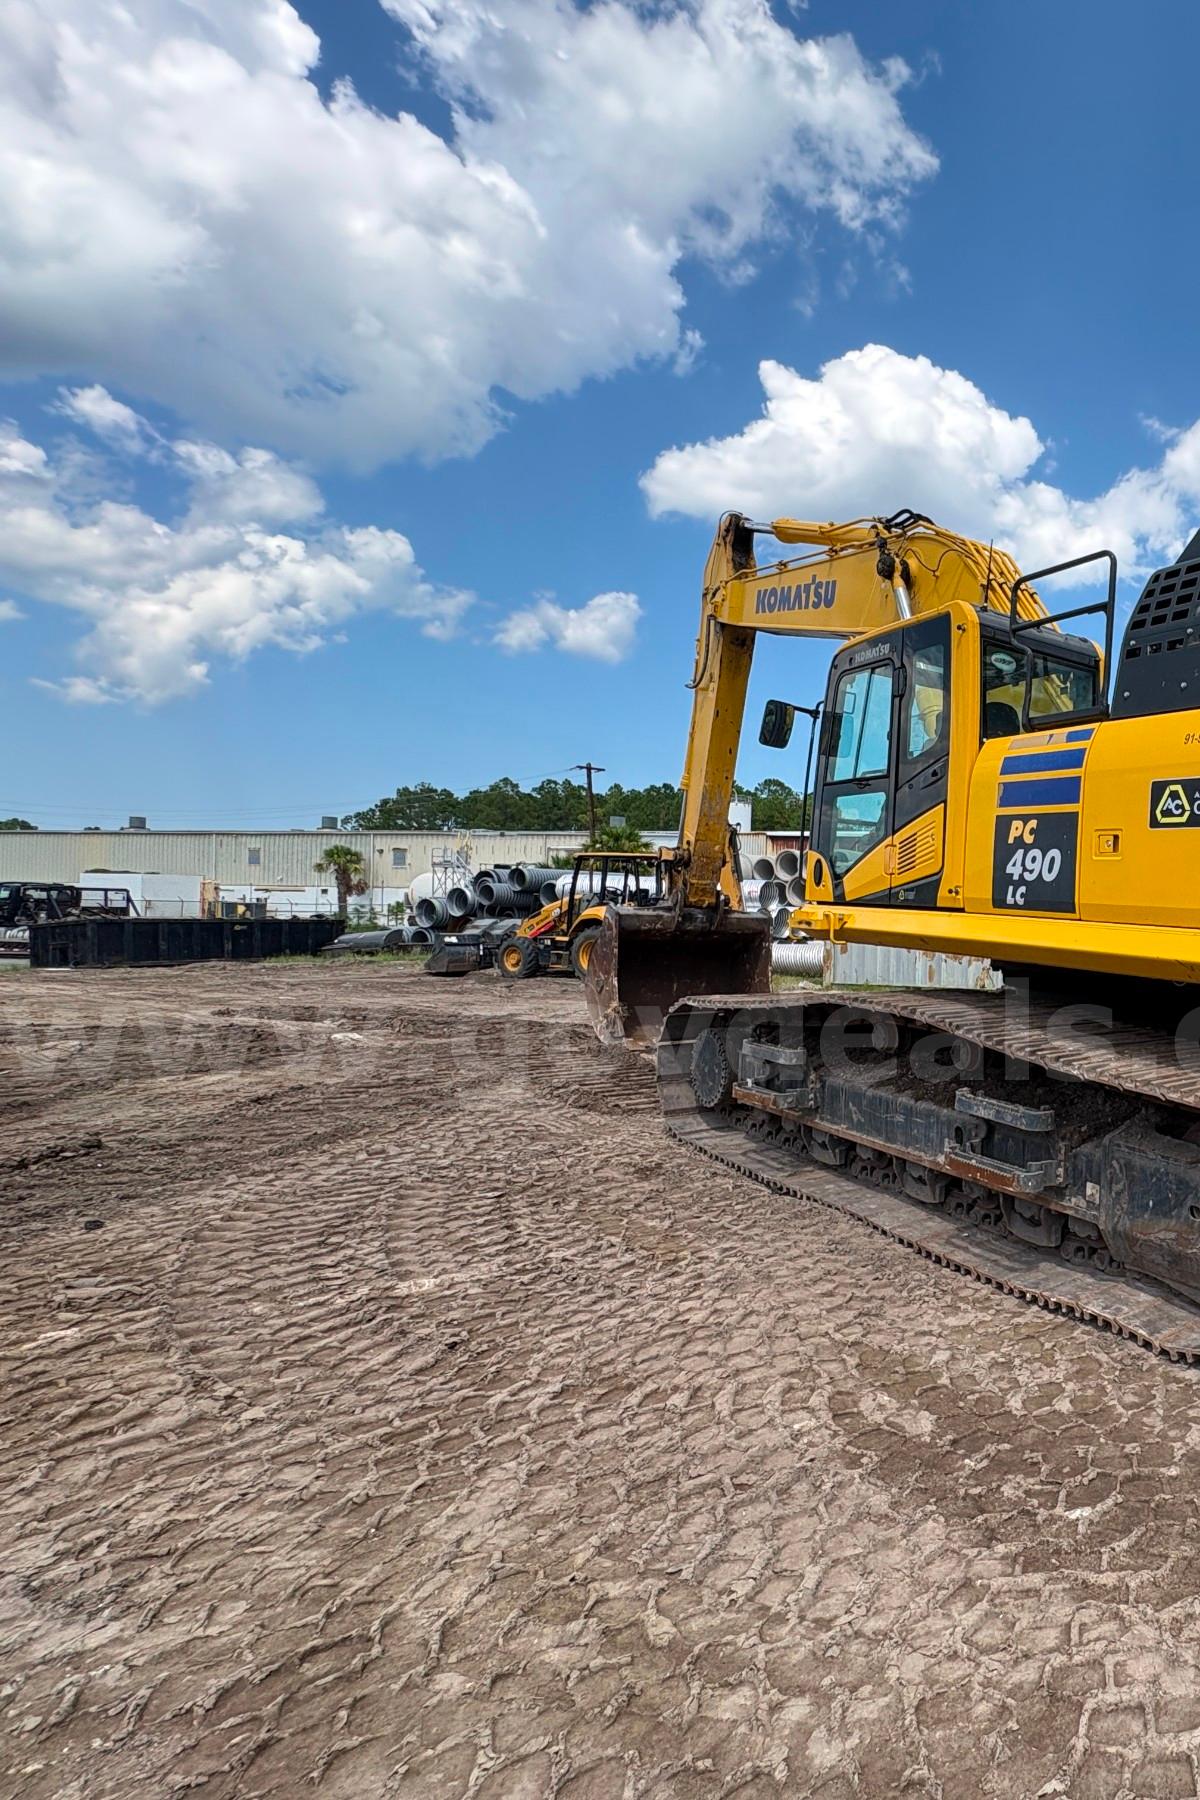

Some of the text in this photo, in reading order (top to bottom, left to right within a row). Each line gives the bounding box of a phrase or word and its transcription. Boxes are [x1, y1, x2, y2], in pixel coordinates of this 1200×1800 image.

[756, 575, 837, 614] KOMATSU
[855, 643, 890, 662] KOMATSU
[1163, 797, 1183, 815] AC
[1008, 819, 1038, 844] PC
[1006, 848, 1062, 882] 490
[1006, 886, 1027, 905] LC
